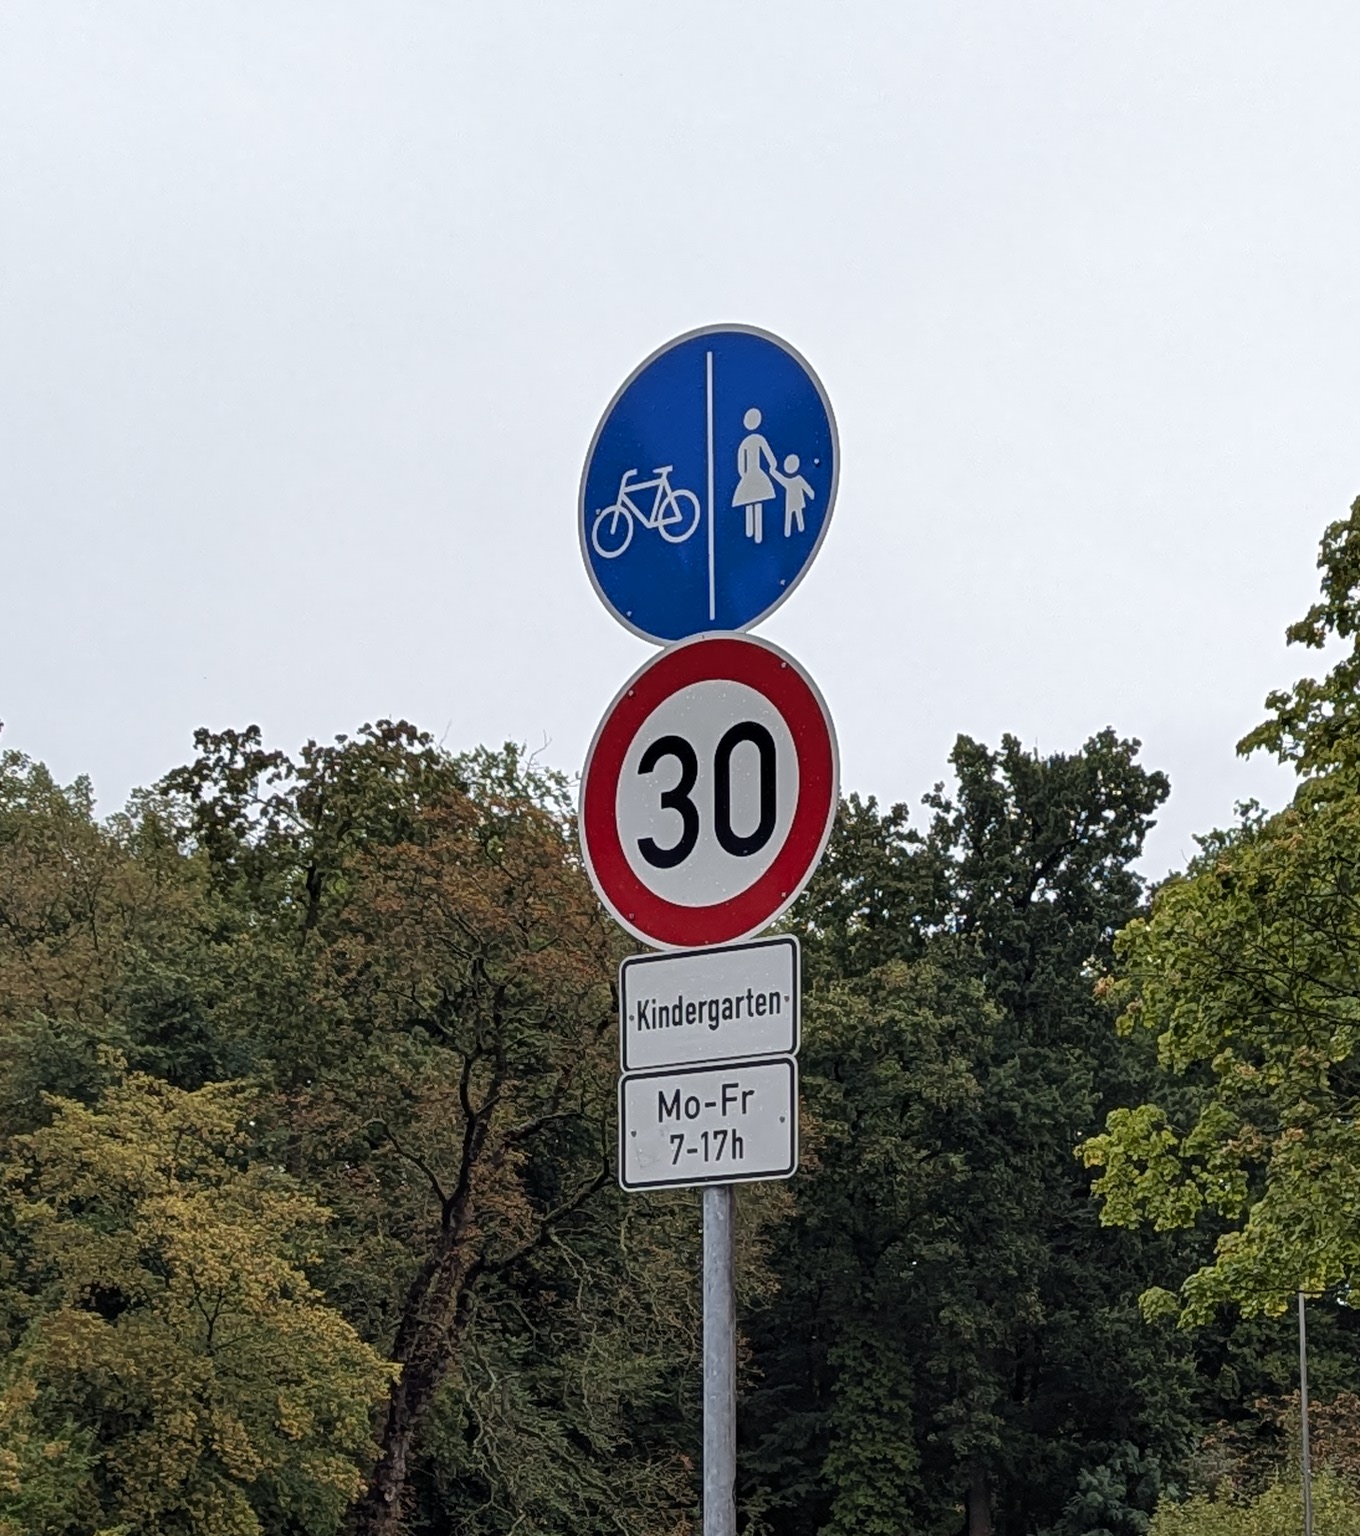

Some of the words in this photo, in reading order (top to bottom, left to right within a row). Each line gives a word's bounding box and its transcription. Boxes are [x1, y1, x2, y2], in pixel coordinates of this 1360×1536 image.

[637, 720, 777, 869] 30
[637, 988, 781, 1031] Kindergarten
[658, 1082, 755, 1123] Mo-Fr
[669, 1128, 745, 1165] 7-17h
